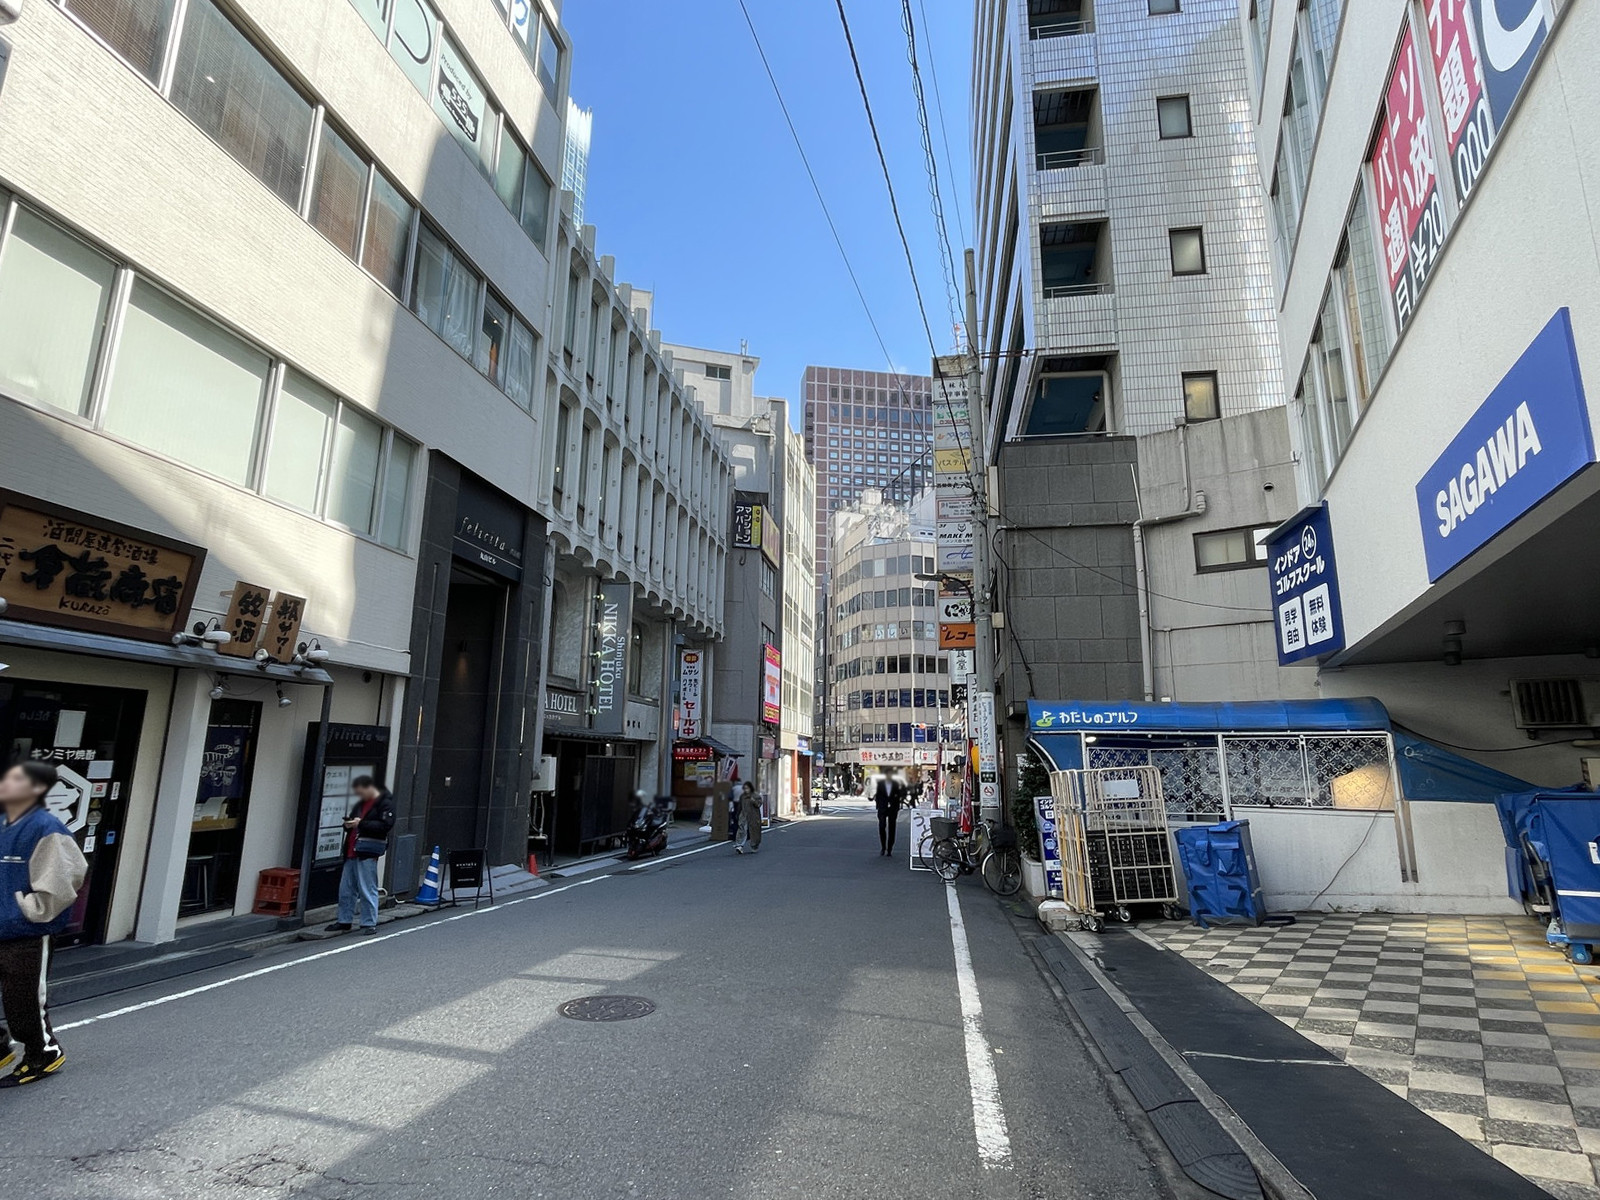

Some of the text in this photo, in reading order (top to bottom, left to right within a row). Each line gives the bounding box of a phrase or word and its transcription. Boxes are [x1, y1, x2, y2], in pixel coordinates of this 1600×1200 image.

[1435, 400, 1543, 538] SAGAWA
[1274, 543, 1301, 575] インドア
[1276, 554, 1326, 595] ゴルフスクール
[599, 602, 619, 714] NIKKA HOTEL
[615, 636, 626, 679] Shinjuku
[561, 693, 577, 712] HOTEL
[682, 700, 696, 737] セール中
[1059, 711, 1138, 724] わたしのゴルフ
[31, 748, 97, 760] キンミヤ焼酎
